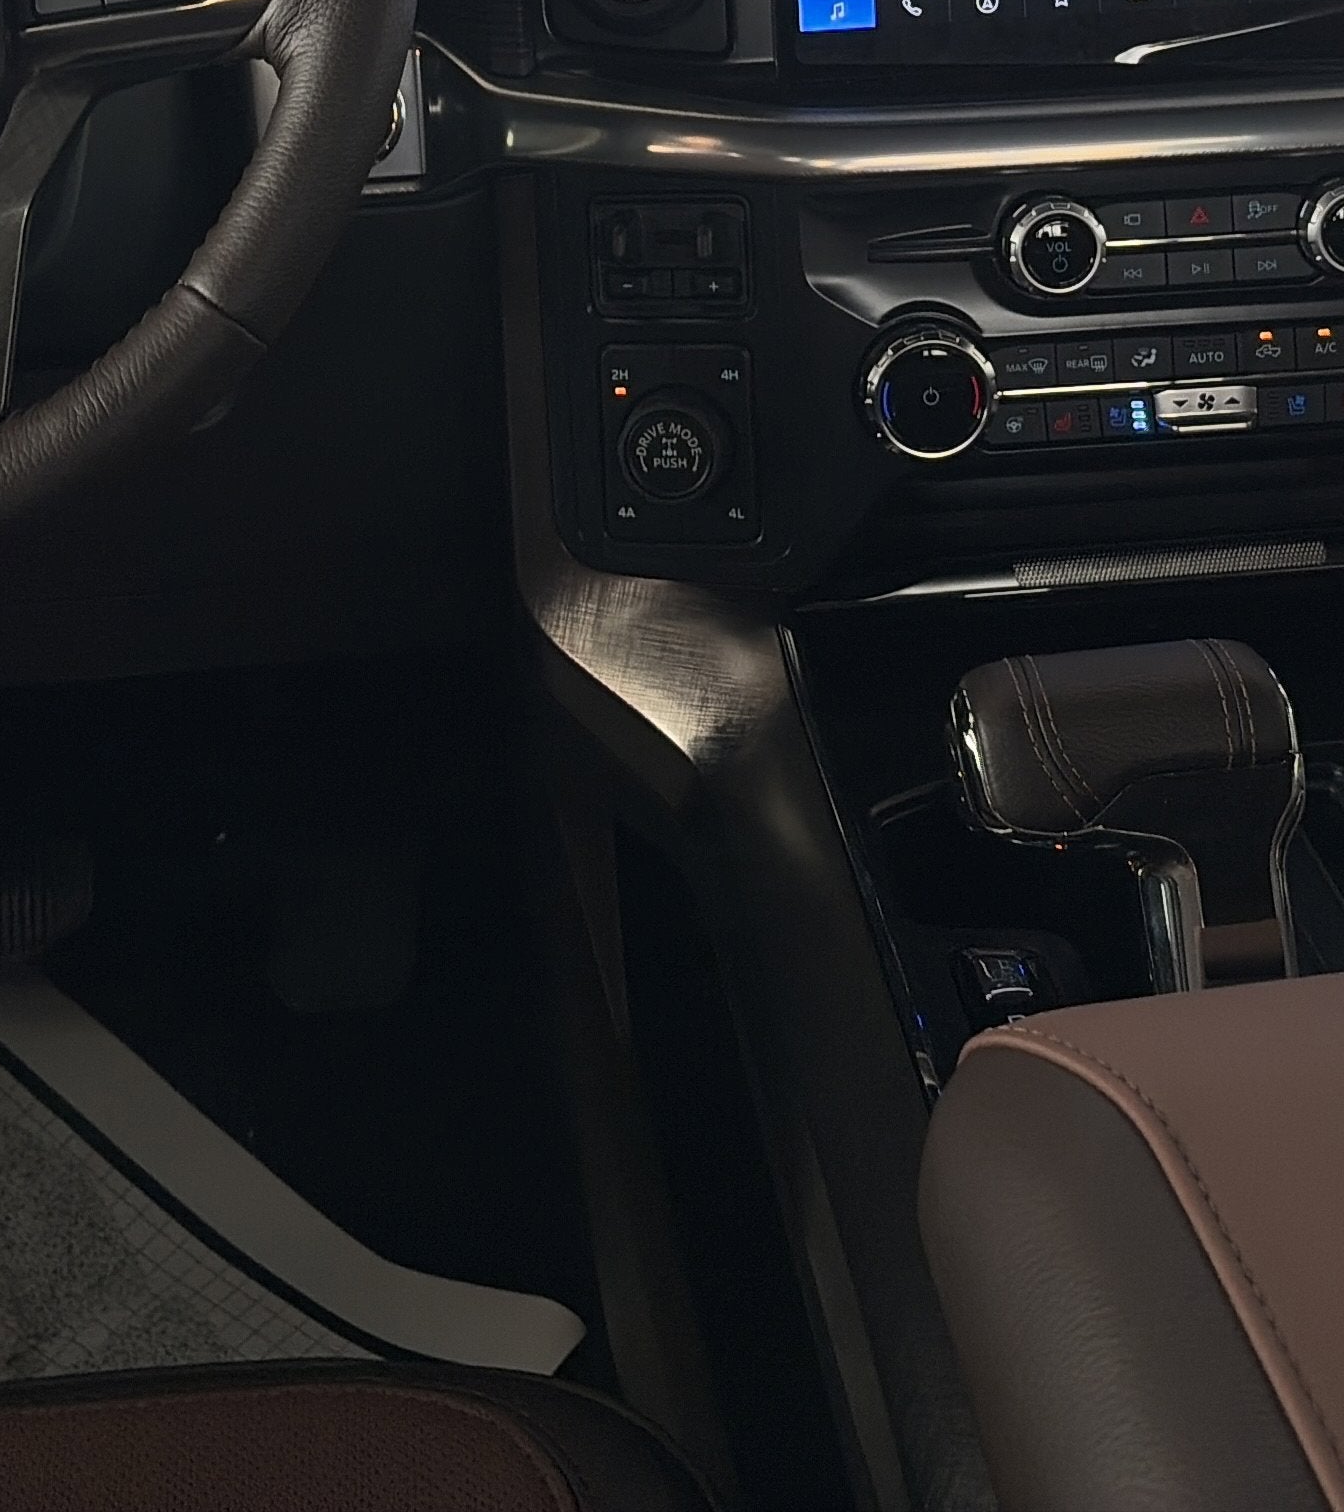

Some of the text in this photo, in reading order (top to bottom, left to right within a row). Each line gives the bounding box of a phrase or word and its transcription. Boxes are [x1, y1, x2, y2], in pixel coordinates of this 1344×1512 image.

[1259, 203, 1278, 214] OFF
[1046, 241, 1072, 253] VOL
[1314, 342, 1337, 355] A/C
[1188, 352, 1224, 363] AUTO
[1005, 362, 1029, 374] MAX
[1066, 358, 1090, 370] REAR
[611, 369, 629, 382] 2H
[720, 369, 739, 382] 4H
[636, 421, 702, 457] DRIVE MODE
[653, 457, 688, 469] PUSH
[618, 507, 636, 518] 4A
[728, 507, 745, 519] 4L
